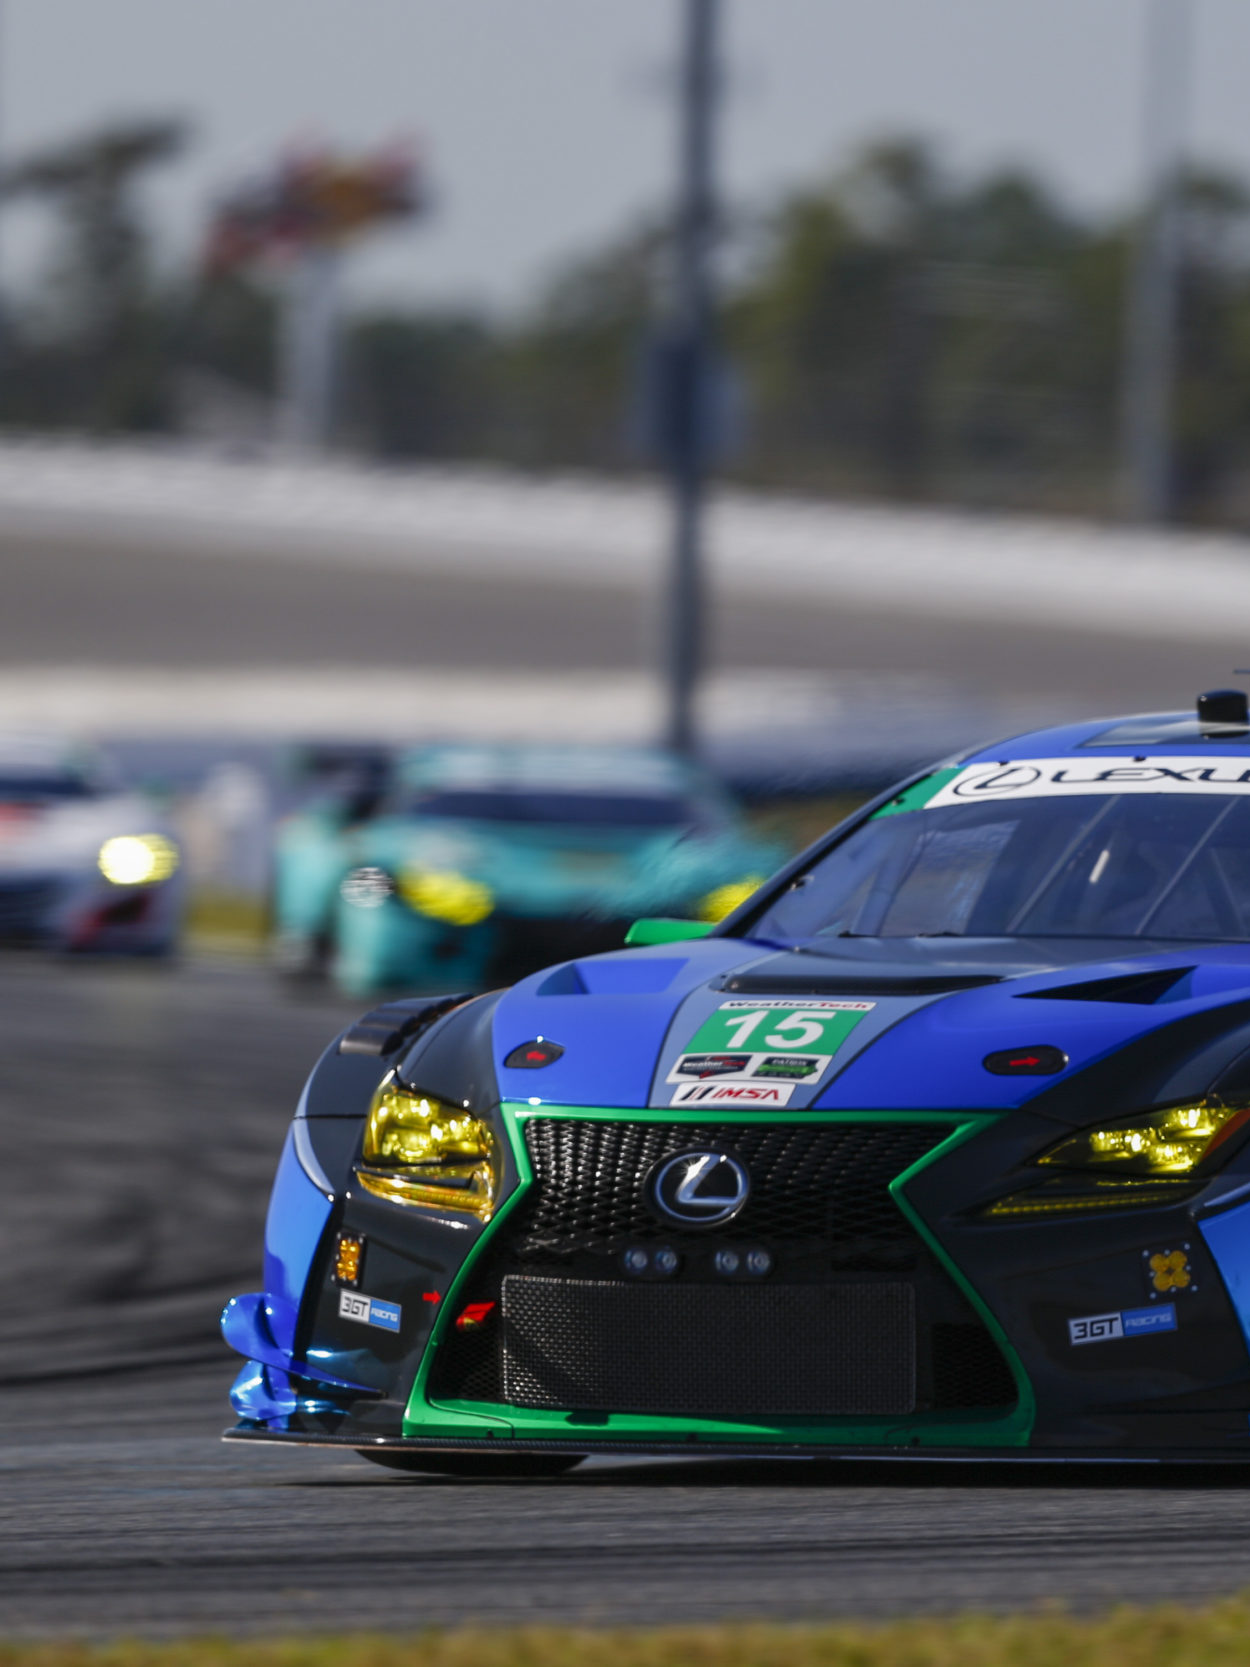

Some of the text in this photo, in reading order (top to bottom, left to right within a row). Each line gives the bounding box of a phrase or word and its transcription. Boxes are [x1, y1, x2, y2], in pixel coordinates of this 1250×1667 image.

[729, 1001, 868, 1010] WeatherTech
[725, 1010, 837, 1048] 15
[711, 1088, 779, 1101] IMSA
[1073, 1317, 1119, 1340] 3GT
